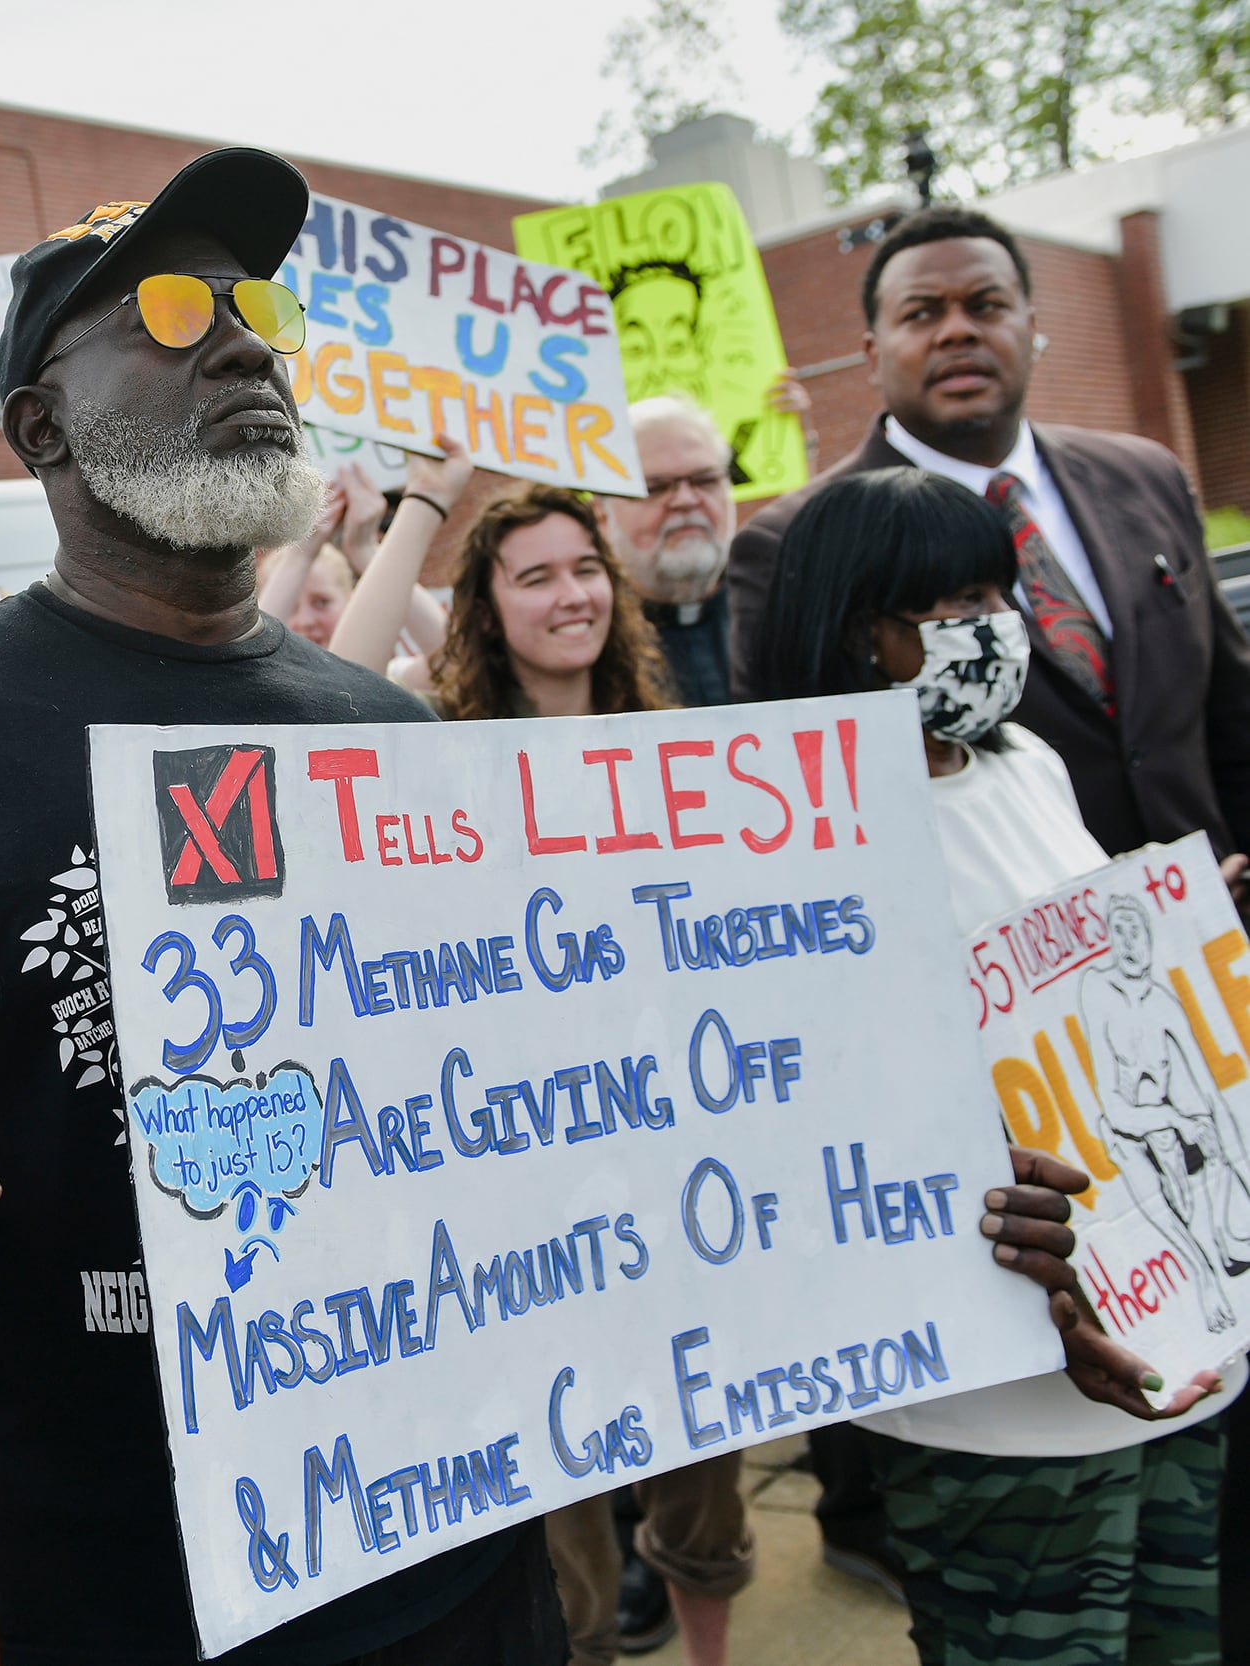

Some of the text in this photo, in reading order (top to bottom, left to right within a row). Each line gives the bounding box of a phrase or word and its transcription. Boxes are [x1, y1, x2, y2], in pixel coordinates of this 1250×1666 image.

[291, 200, 609, 335] HIS PLACE
[283, 262, 589, 403] ES US
[285, 341, 630, 480] OGETHER
[517, 718, 869, 856] LIES!!
[999, 888, 1108, 988] TURBINES
[1143, 864, 1187, 914] to
[51, 987, 96, 1022] GOOCH
[141, 914, 278, 1074] 33
[299, 913, 523, 1027] METHANE
[632, 881, 876, 971] TURBINES
[74, 1020, 114, 1052] BATCHE
[133, 1074, 306, 1147] What happened
[173, 1123, 308, 1192] to just 15?
[440, 1047, 675, 1158] GIVING
[176, 1280, 424, 1434] MASSIVE
[424, 1213, 650, 1351] AMOUNTS
[822, 1142, 959, 1245] HEAT
[1082, 1242, 1189, 1336] them
[235, 1476, 299, 1593] &
[304, 1433, 532, 1578] METHANE
[671, 1322, 950, 1450] EMISSION
